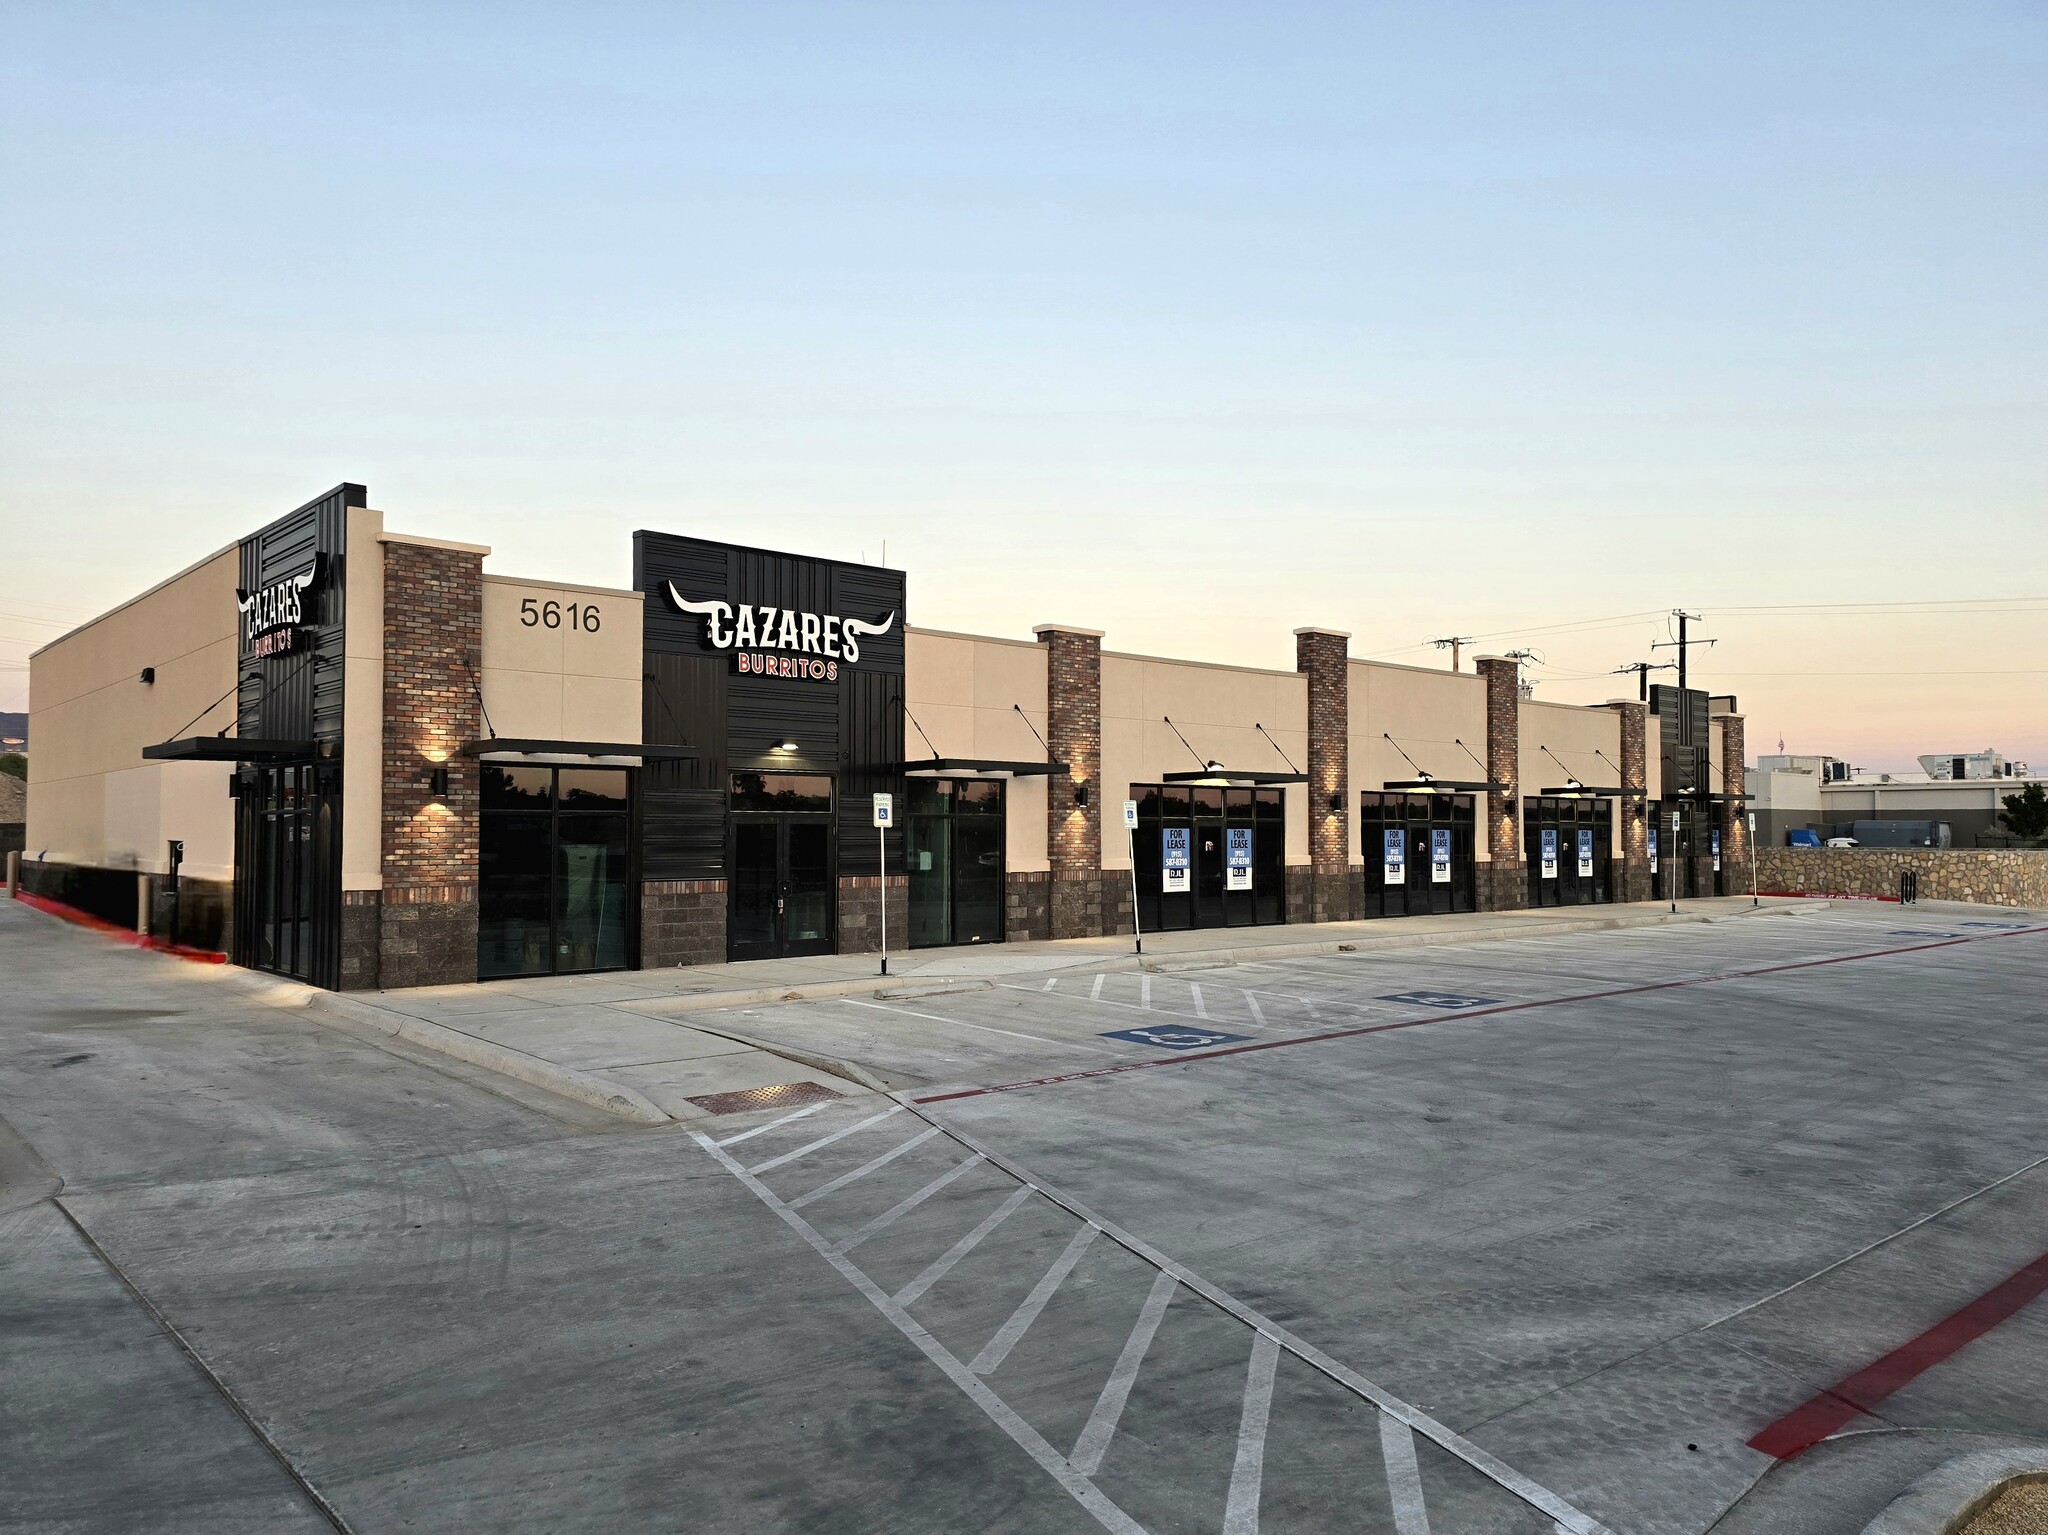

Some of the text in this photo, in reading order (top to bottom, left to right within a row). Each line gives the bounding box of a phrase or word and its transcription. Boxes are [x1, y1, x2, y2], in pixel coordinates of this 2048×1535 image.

[248, 575, 302, 639] CAZARES
[520, 598, 601, 632] 5616
[709, 600, 860, 663] CAZARES
[255, 627, 292, 659] BURRITOS
[738, 652, 838, 681] BURRITOS
[1167, 840, 1185, 848] LEASE
[1170, 830, 1183, 839] FOR
[1231, 840, 1248, 848] LEASE
[1233, 830, 1245, 839] FOR
[1233, 868, 1246, 876] RJL
